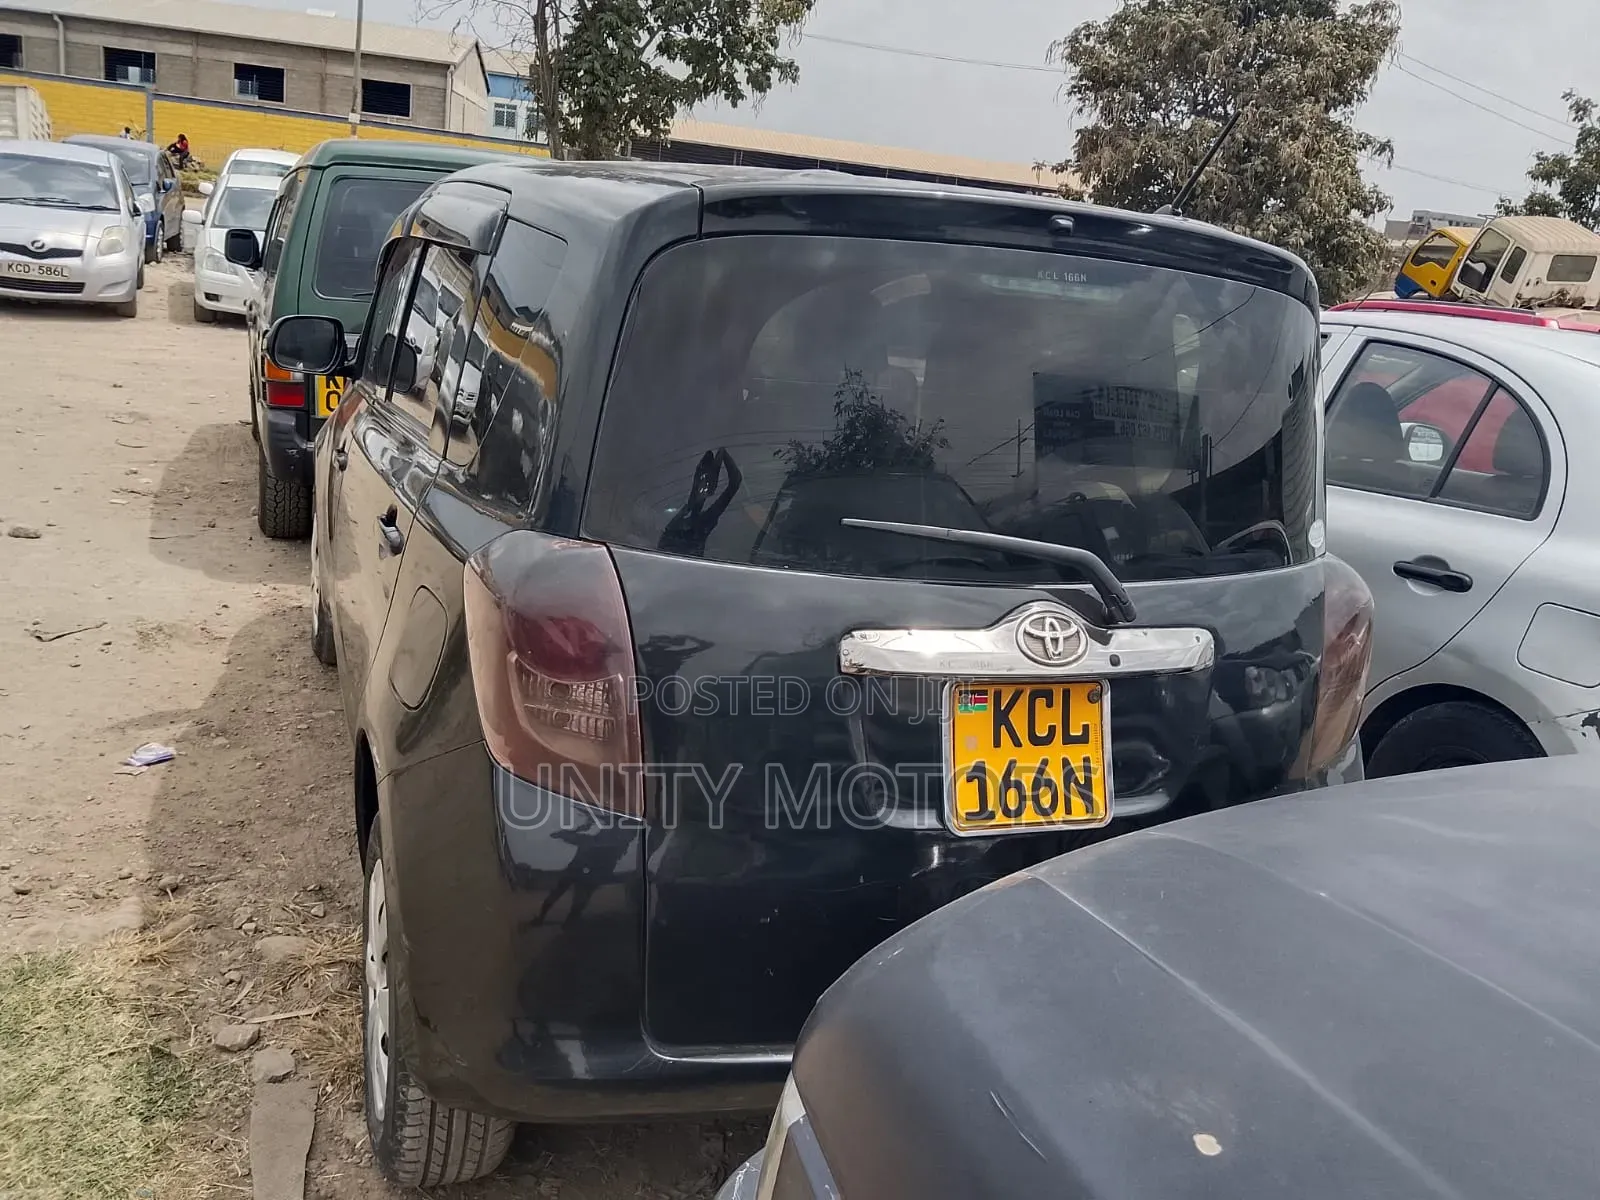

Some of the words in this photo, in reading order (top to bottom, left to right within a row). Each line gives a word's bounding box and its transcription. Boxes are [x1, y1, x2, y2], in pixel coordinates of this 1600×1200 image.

[7, 262, 31, 274] KCD
[38, 265, 69, 278] 586L
[992, 687, 1090, 748] KCL
[965, 755, 1095, 821] 166N
